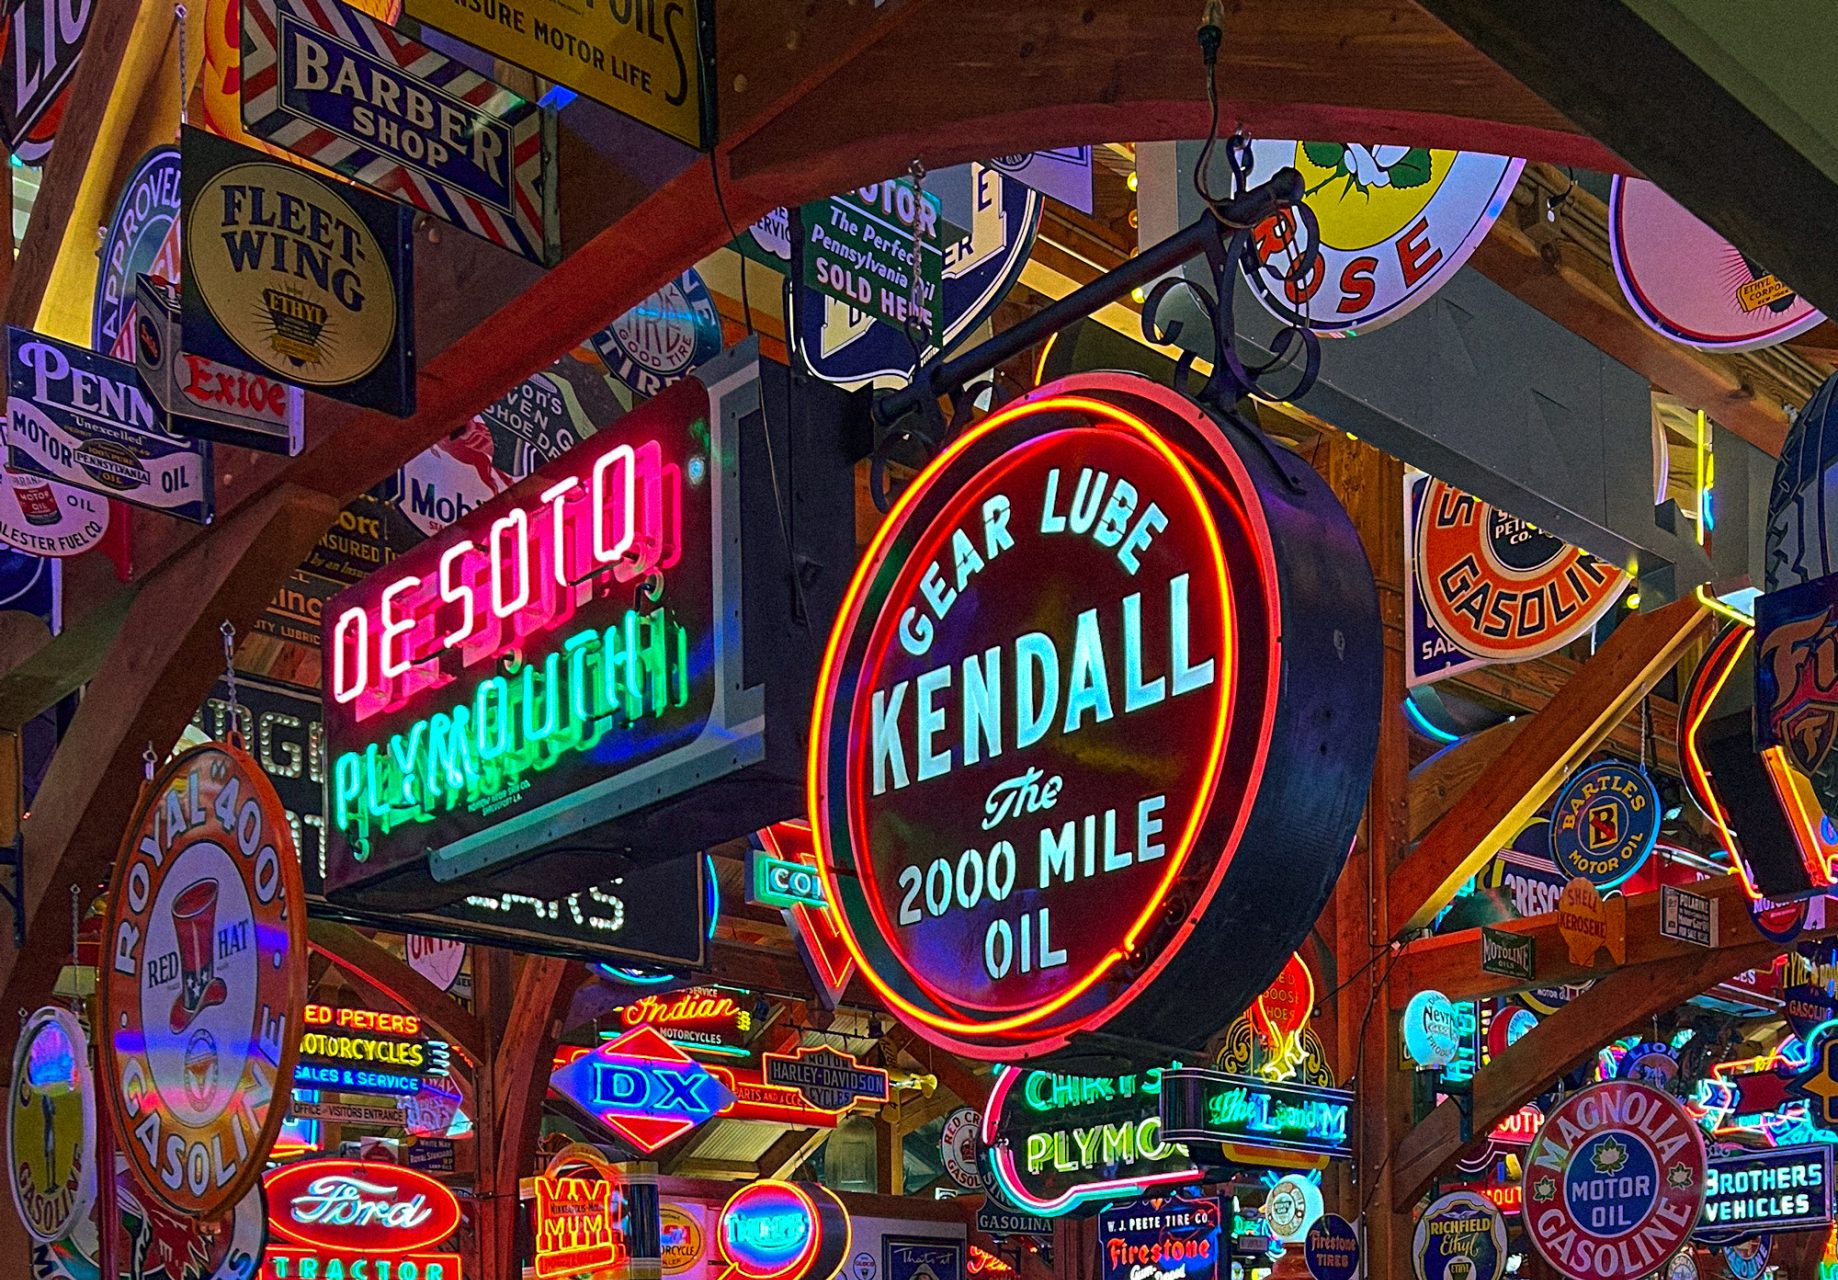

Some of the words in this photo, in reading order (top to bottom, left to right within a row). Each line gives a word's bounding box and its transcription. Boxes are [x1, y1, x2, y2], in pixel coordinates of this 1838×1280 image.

[534, 17, 606, 72] MOTOR
[611, 55, 653, 95] LIFE
[295, 32, 505, 188] BARBER
[352, 104, 449, 168] SHOP
[830, 205, 858, 236] The
[221, 229, 366, 313] WING
[810, 223, 908, 289] Pennsylvania
[816, 256, 872, 304] SOLD
[1743, 276, 1772, 296] ETHYL
[618, 328, 662, 367] GOOD
[667, 336, 693, 367] TIRE
[182, 354, 287, 417] Exide
[12, 410, 73, 469] MOTOR
[76, 451, 149, 483] PENNSYLVANIA
[161, 465, 190, 494] OIL
[102, 472, 123, 485] OIL
[66, 494, 96, 513] OIL
[58, 533, 89, 551] FUEL
[1510, 532, 1533, 546] CO.
[1439, 550, 1607, 640] GASOLIN
[280, 625, 322, 646] LUBRIC
[335, 608, 660, 832] PLYMOUTH
[1562, 774, 1646, 831] BARTLES
[1568, 849, 1620, 876] MOTOR
[1620, 830, 1644, 862] OIL
[114, 768, 208, 977] ROYAL
[213, 776, 280, 906] 400
[1567, 888, 1598, 914] SHELL
[217, 917, 250, 962] HAT
[1559, 910, 1606, 939] KEROSENE
[146, 951, 181, 990] RED
[303, 1004, 333, 1024] ED
[624, 994, 739, 1025] Indian
[659, 1026, 722, 1044] MOTORCYCLES
[1629, 1041, 1681, 1060] LION
[293, 1065, 340, 1083] SALES
[343, 1070, 354, 1085] &
[357, 1072, 420, 1092] SERVICE
[591, 1062, 710, 1113] DX
[772, 1060, 885, 1094] HARLEY-DAVIDSON
[121, 1004, 286, 1197] GASOLINE
[808, 1086, 851, 1104] CYCLES
[293, 1103, 322, 1115] OFFICE
[328, 1105, 364, 1119] VISITORS
[363, 1106, 405, 1122] ENTRANCE
[943, 1116, 961, 1145] RED
[1533, 1089, 1691, 1174] MAGNOLIA
[1571, 1174, 1651, 1202] MOTOR
[1705, 1163, 1823, 1197] BROTHERS
[290, 1175, 434, 1229] Ford
[1591, 1204, 1632, 1229] OIL
[1705, 1193, 1810, 1222] VEHICLES
[979, 1214, 1053, 1232] GASOLINA
[1129, 1216, 1161, 1232] PEETE
[1165, 1212, 1190, 1228] TIRE
[1430, 1217, 1491, 1235] RICHFIELD
[1106, 1237, 1211, 1271] Firestone
[1309, 1229, 1357, 1251] Firestone
[1439, 1231, 1479, 1259] Ethyl
[1536, 1198, 1692, 1280] GASOLINE
[1316, 1253, 1349, 1268] TIRES
